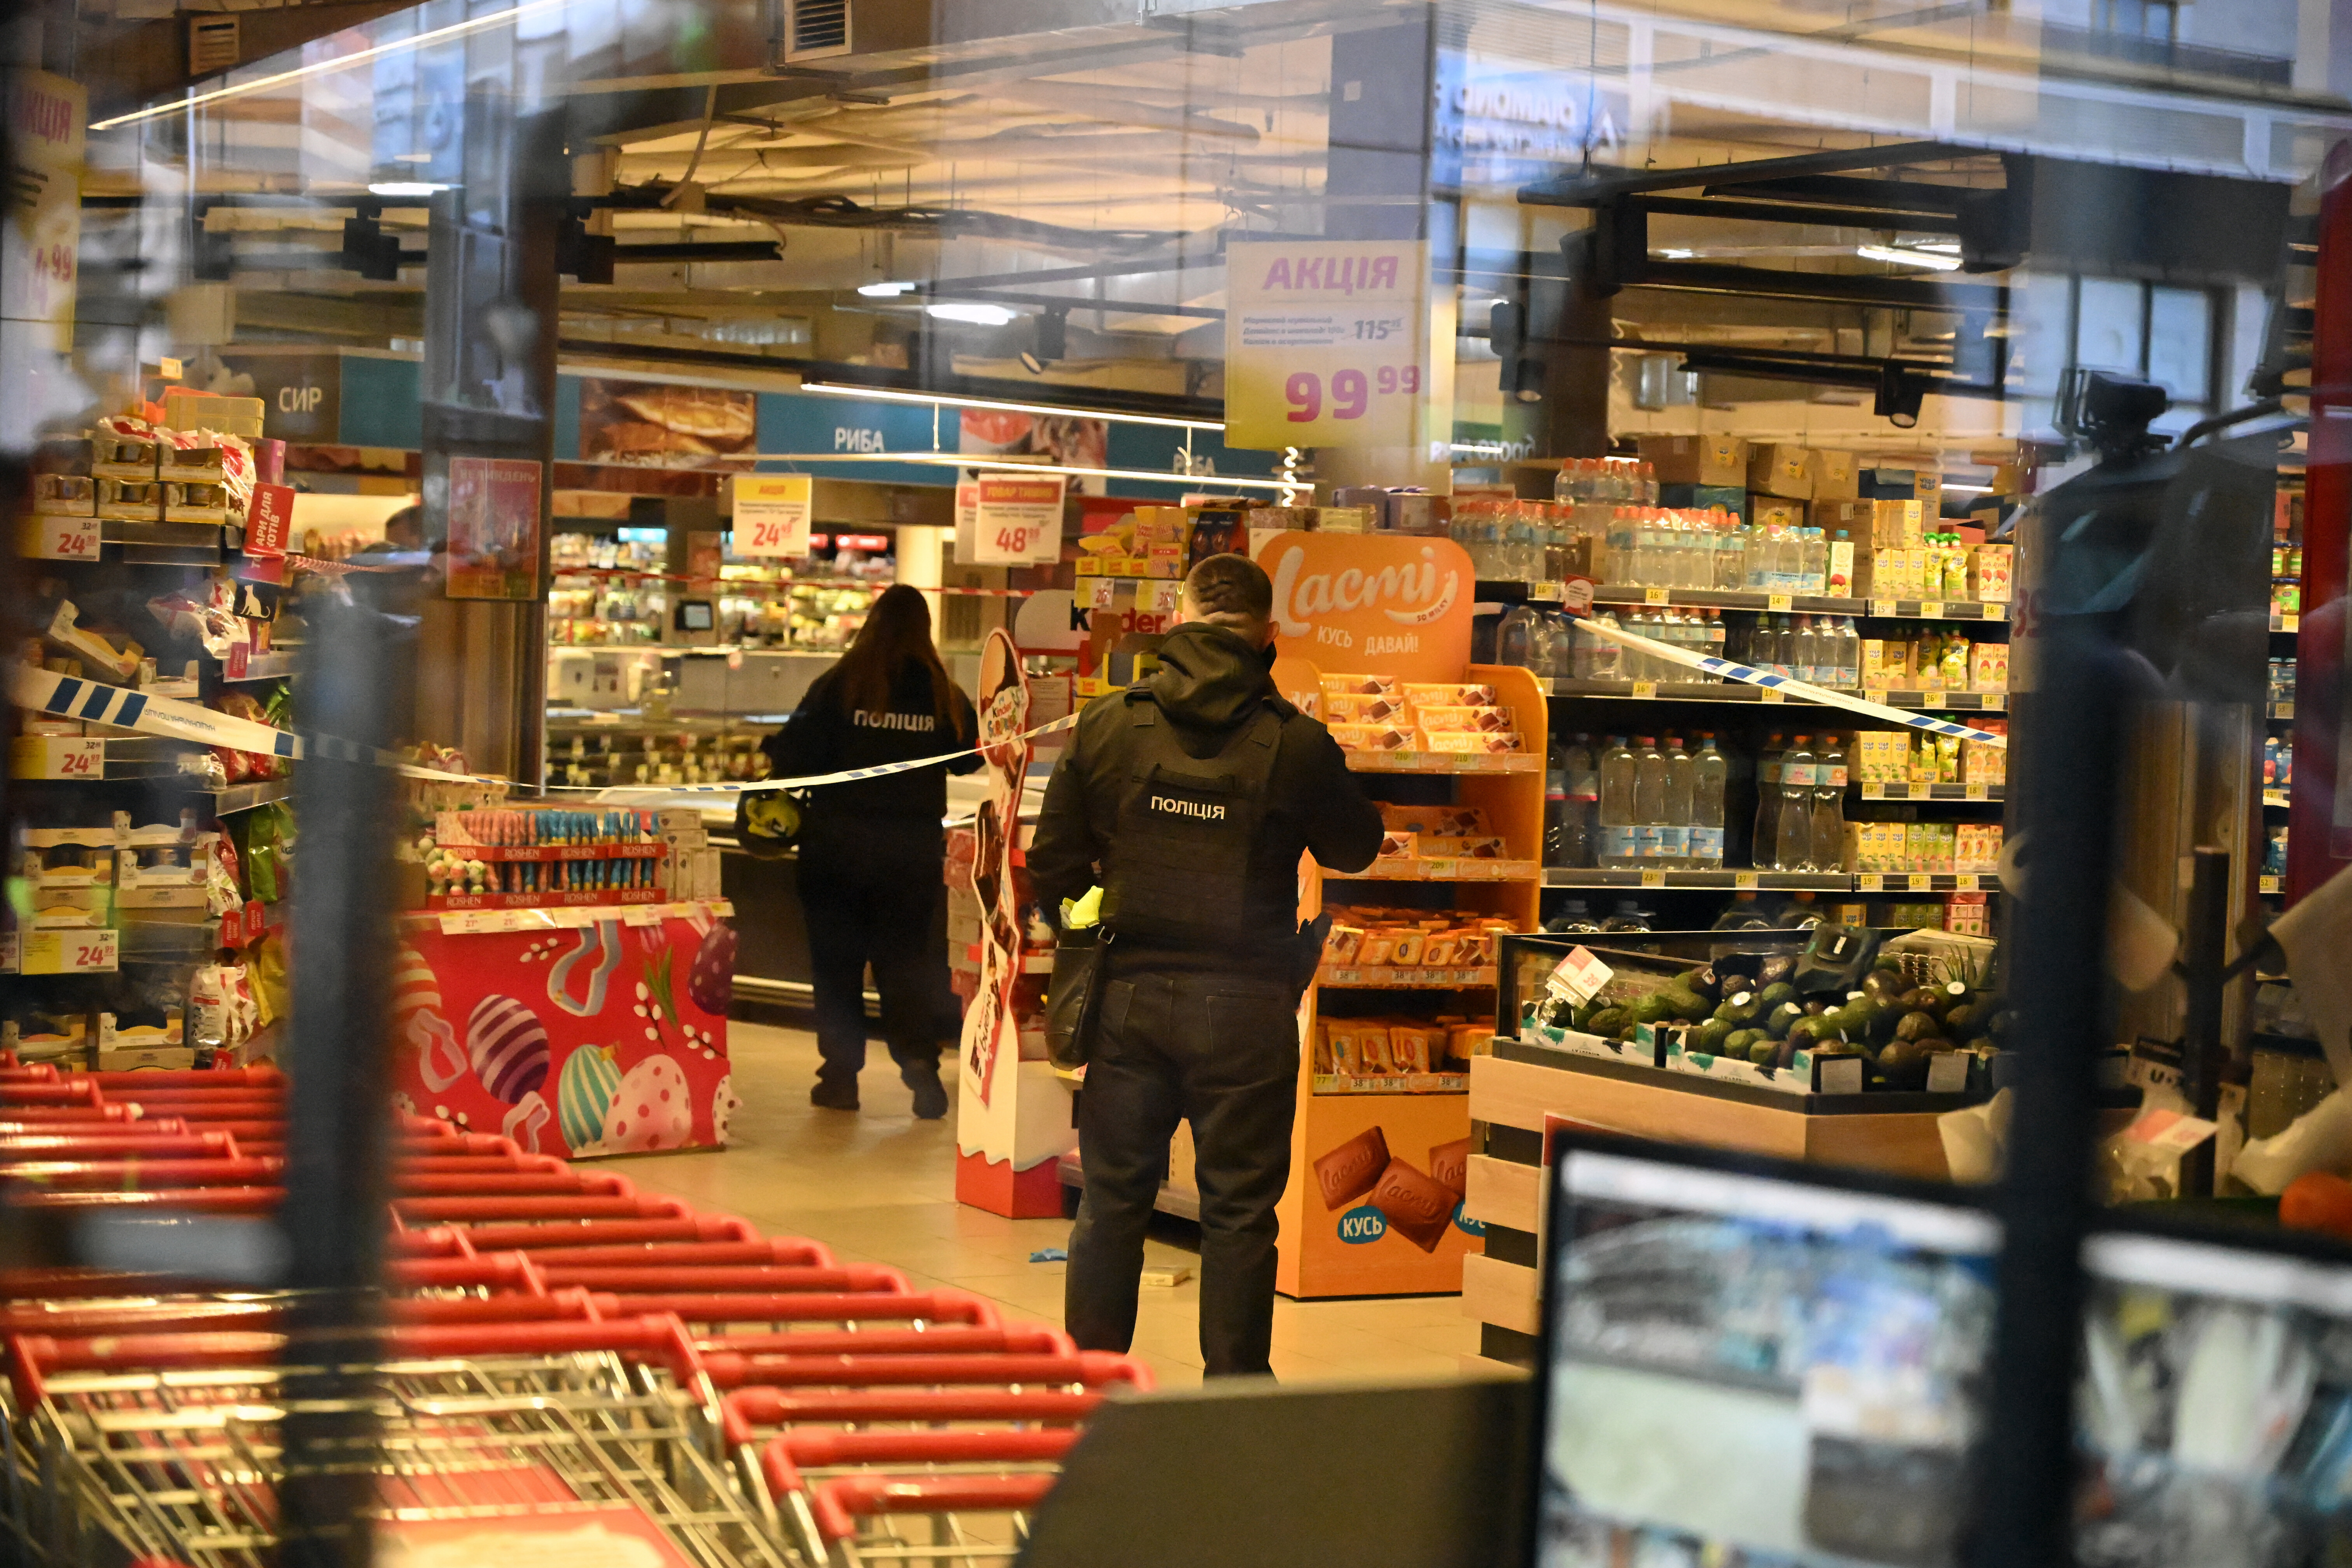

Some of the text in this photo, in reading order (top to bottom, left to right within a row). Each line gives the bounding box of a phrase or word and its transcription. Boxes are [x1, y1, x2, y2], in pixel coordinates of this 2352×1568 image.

[1263, 256, 1399, 296] АКЦІЯ
[1354, 320, 1390, 340] 115
[278, 387, 322, 413] СИР
[1285, 365, 1421, 423] 99 99
[835, 427, 884, 453] РИБА
[260, 491, 273, 521] ДЛЯ
[57, 533, 86, 554] 24
[752, 522, 779, 546] 24
[996, 527, 1027, 553] 48
[1269, 545, 1438, 637] Lacmi
[1537, 585, 1547, 594] 16
[1649, 591, 1659, 599] 16
[1317, 625, 1419, 656] КУСЬ ДАВАЙ!
[1636, 684, 1645, 693] 16
[1764, 688, 1773, 696] 17
[1809, 689, 1853, 705] НАЦІОНАЛЬНА
[144, 708, 216, 732] НАЦІОНАЛЬНА ПОЛІЦІЯ
[853, 709, 935, 732] ПОЛІЦІЯ
[1418, 707, 1458, 729] Lacmi
[1428, 732, 1468, 752] Lacmi
[61, 753, 89, 773] 24
[1150, 794, 1225, 821] ПОЛІЦІЯ
[504, 848, 541, 858] ROSHEN
[560, 847, 596, 858] ROSHEN
[622, 845, 657, 856] ROSHEN
[1644, 873, 1654, 881] 23
[1738, 874, 1747, 883] 27
[446, 896, 482, 906] ROSHEN
[506, 894, 541, 905] ROSHEN
[564, 893, 598, 903] ROSHEN
[621, 891, 656, 901] ROSHEN
[76, 946, 103, 966] 24
[1582, 972, 1597, 988] 39
[1323, 1143, 1379, 1192] Lacmi
[1379, 1174, 1442, 1220] Lacmi
[1342, 1215, 1383, 1237] КУСЬ
